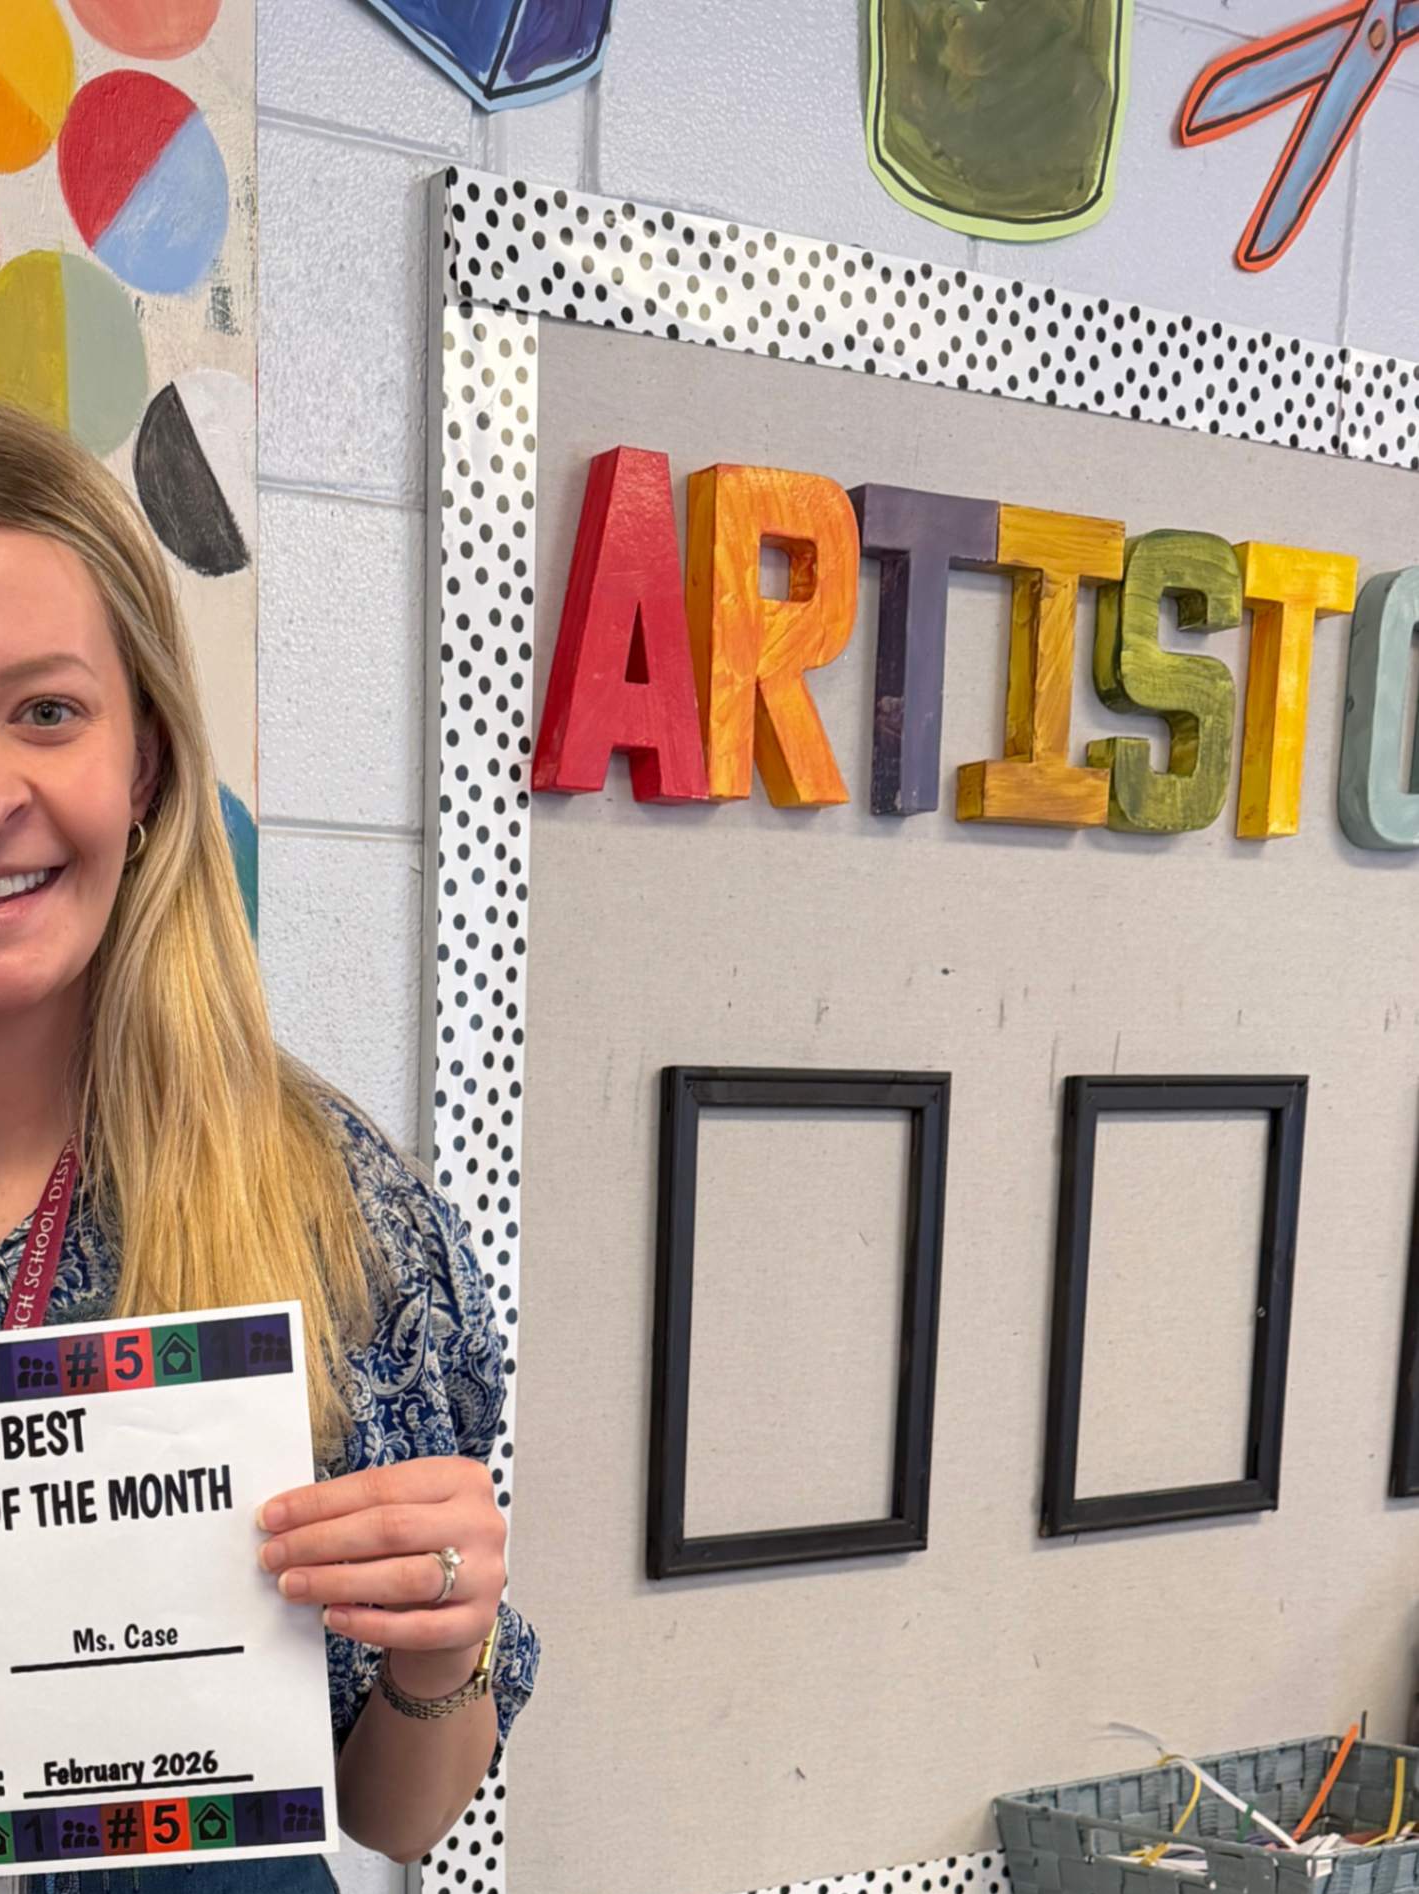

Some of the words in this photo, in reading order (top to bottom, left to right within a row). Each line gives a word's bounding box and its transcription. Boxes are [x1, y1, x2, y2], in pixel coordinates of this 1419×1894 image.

[24, 1200, 59, 1289] SCHOOL
[1, 1407, 87, 1460] BEST
[30, 1480, 98, 1527] THE
[108, 1464, 233, 1521] MONTH
[73, 1628, 115, 1653] Ms.
[124, 1624, 179, 1649] Case
[43, 1758, 145, 1786] February
[152, 1750, 219, 1778] 2026
